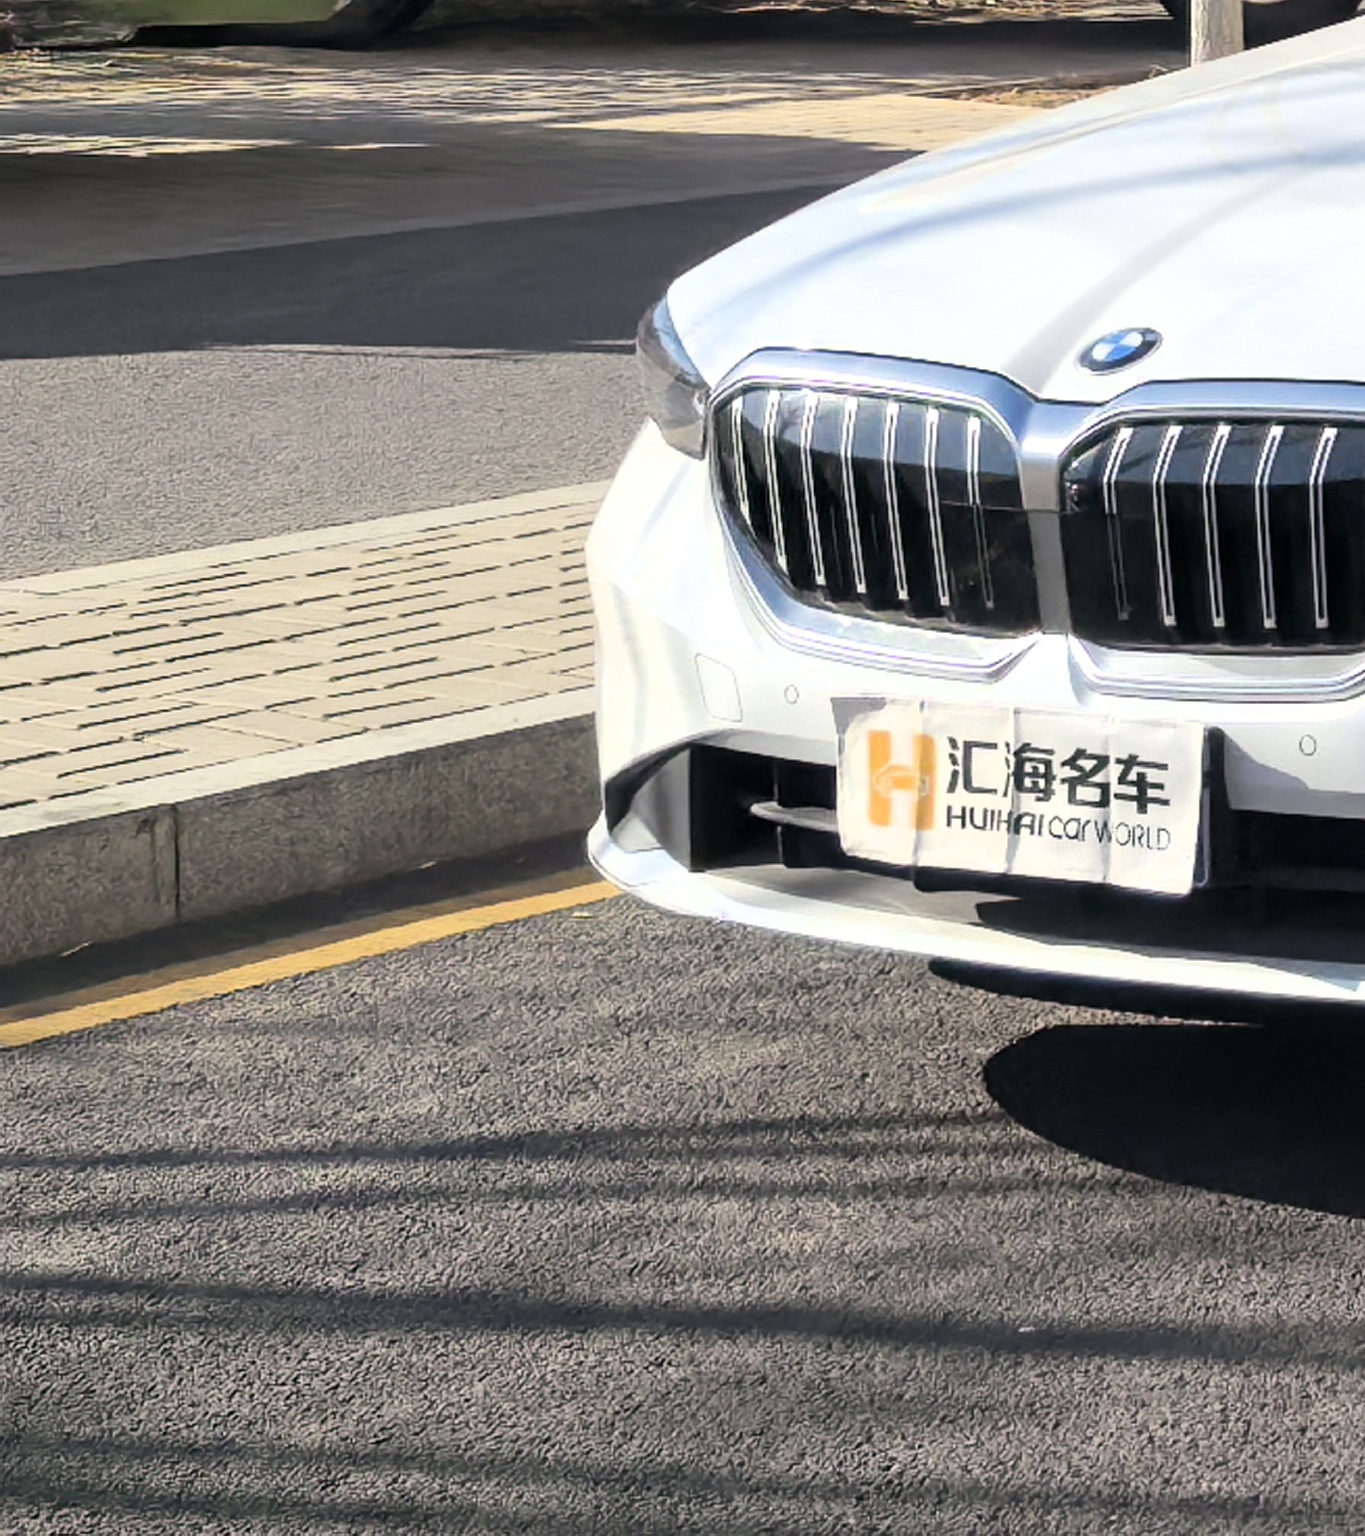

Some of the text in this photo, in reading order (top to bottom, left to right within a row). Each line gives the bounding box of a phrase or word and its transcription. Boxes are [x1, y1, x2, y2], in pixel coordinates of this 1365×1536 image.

[946, 736, 1170, 814] 汇海名车
[946, 805, 1044, 836] HUIHAI
